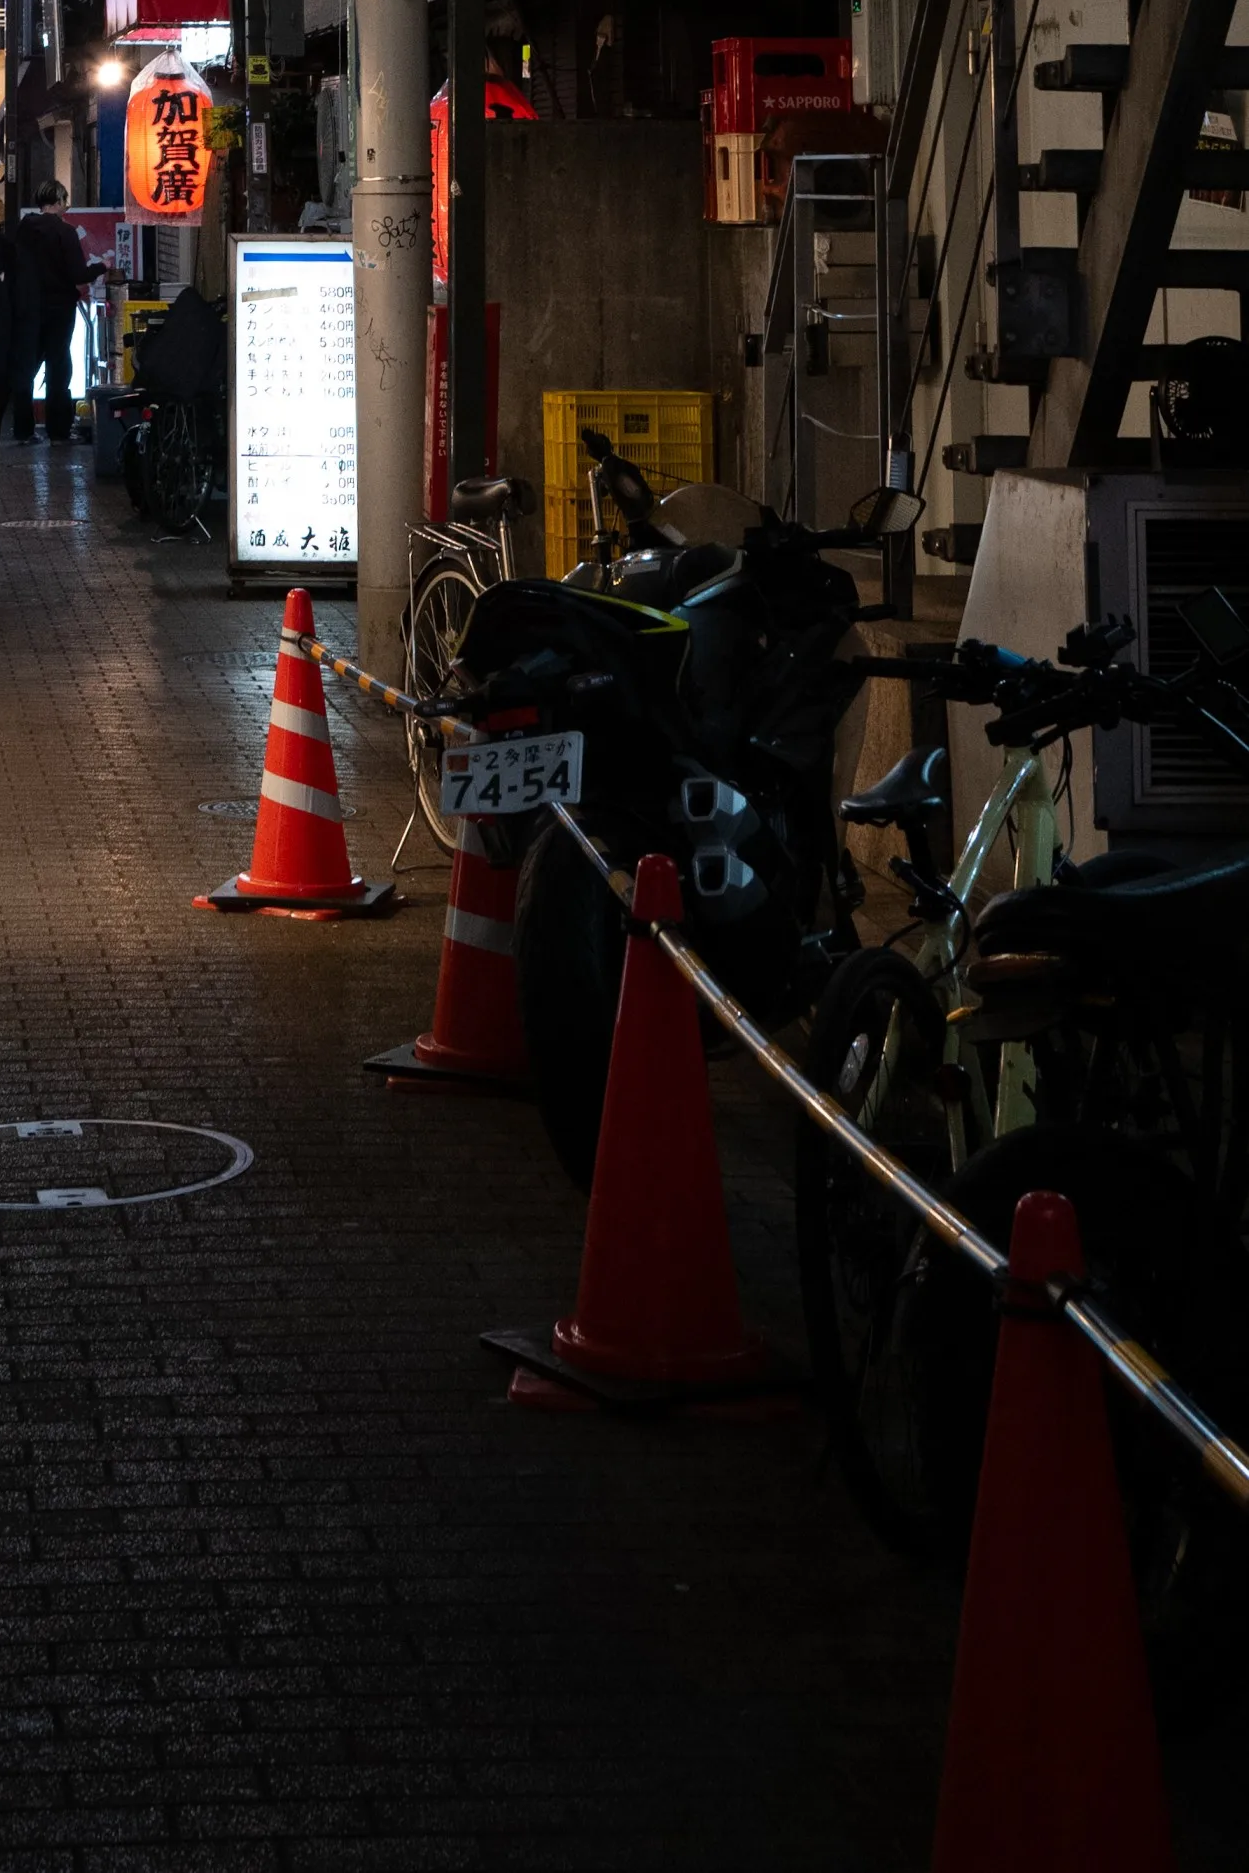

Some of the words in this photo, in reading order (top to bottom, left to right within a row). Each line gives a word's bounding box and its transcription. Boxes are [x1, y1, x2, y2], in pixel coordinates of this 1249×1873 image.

[778, 96, 841, 110] SAPPORO
[151, 89, 200, 206] 加賀廣
[300, 525, 352, 552] 大雅
[450, 759, 571, 810] 74-54
